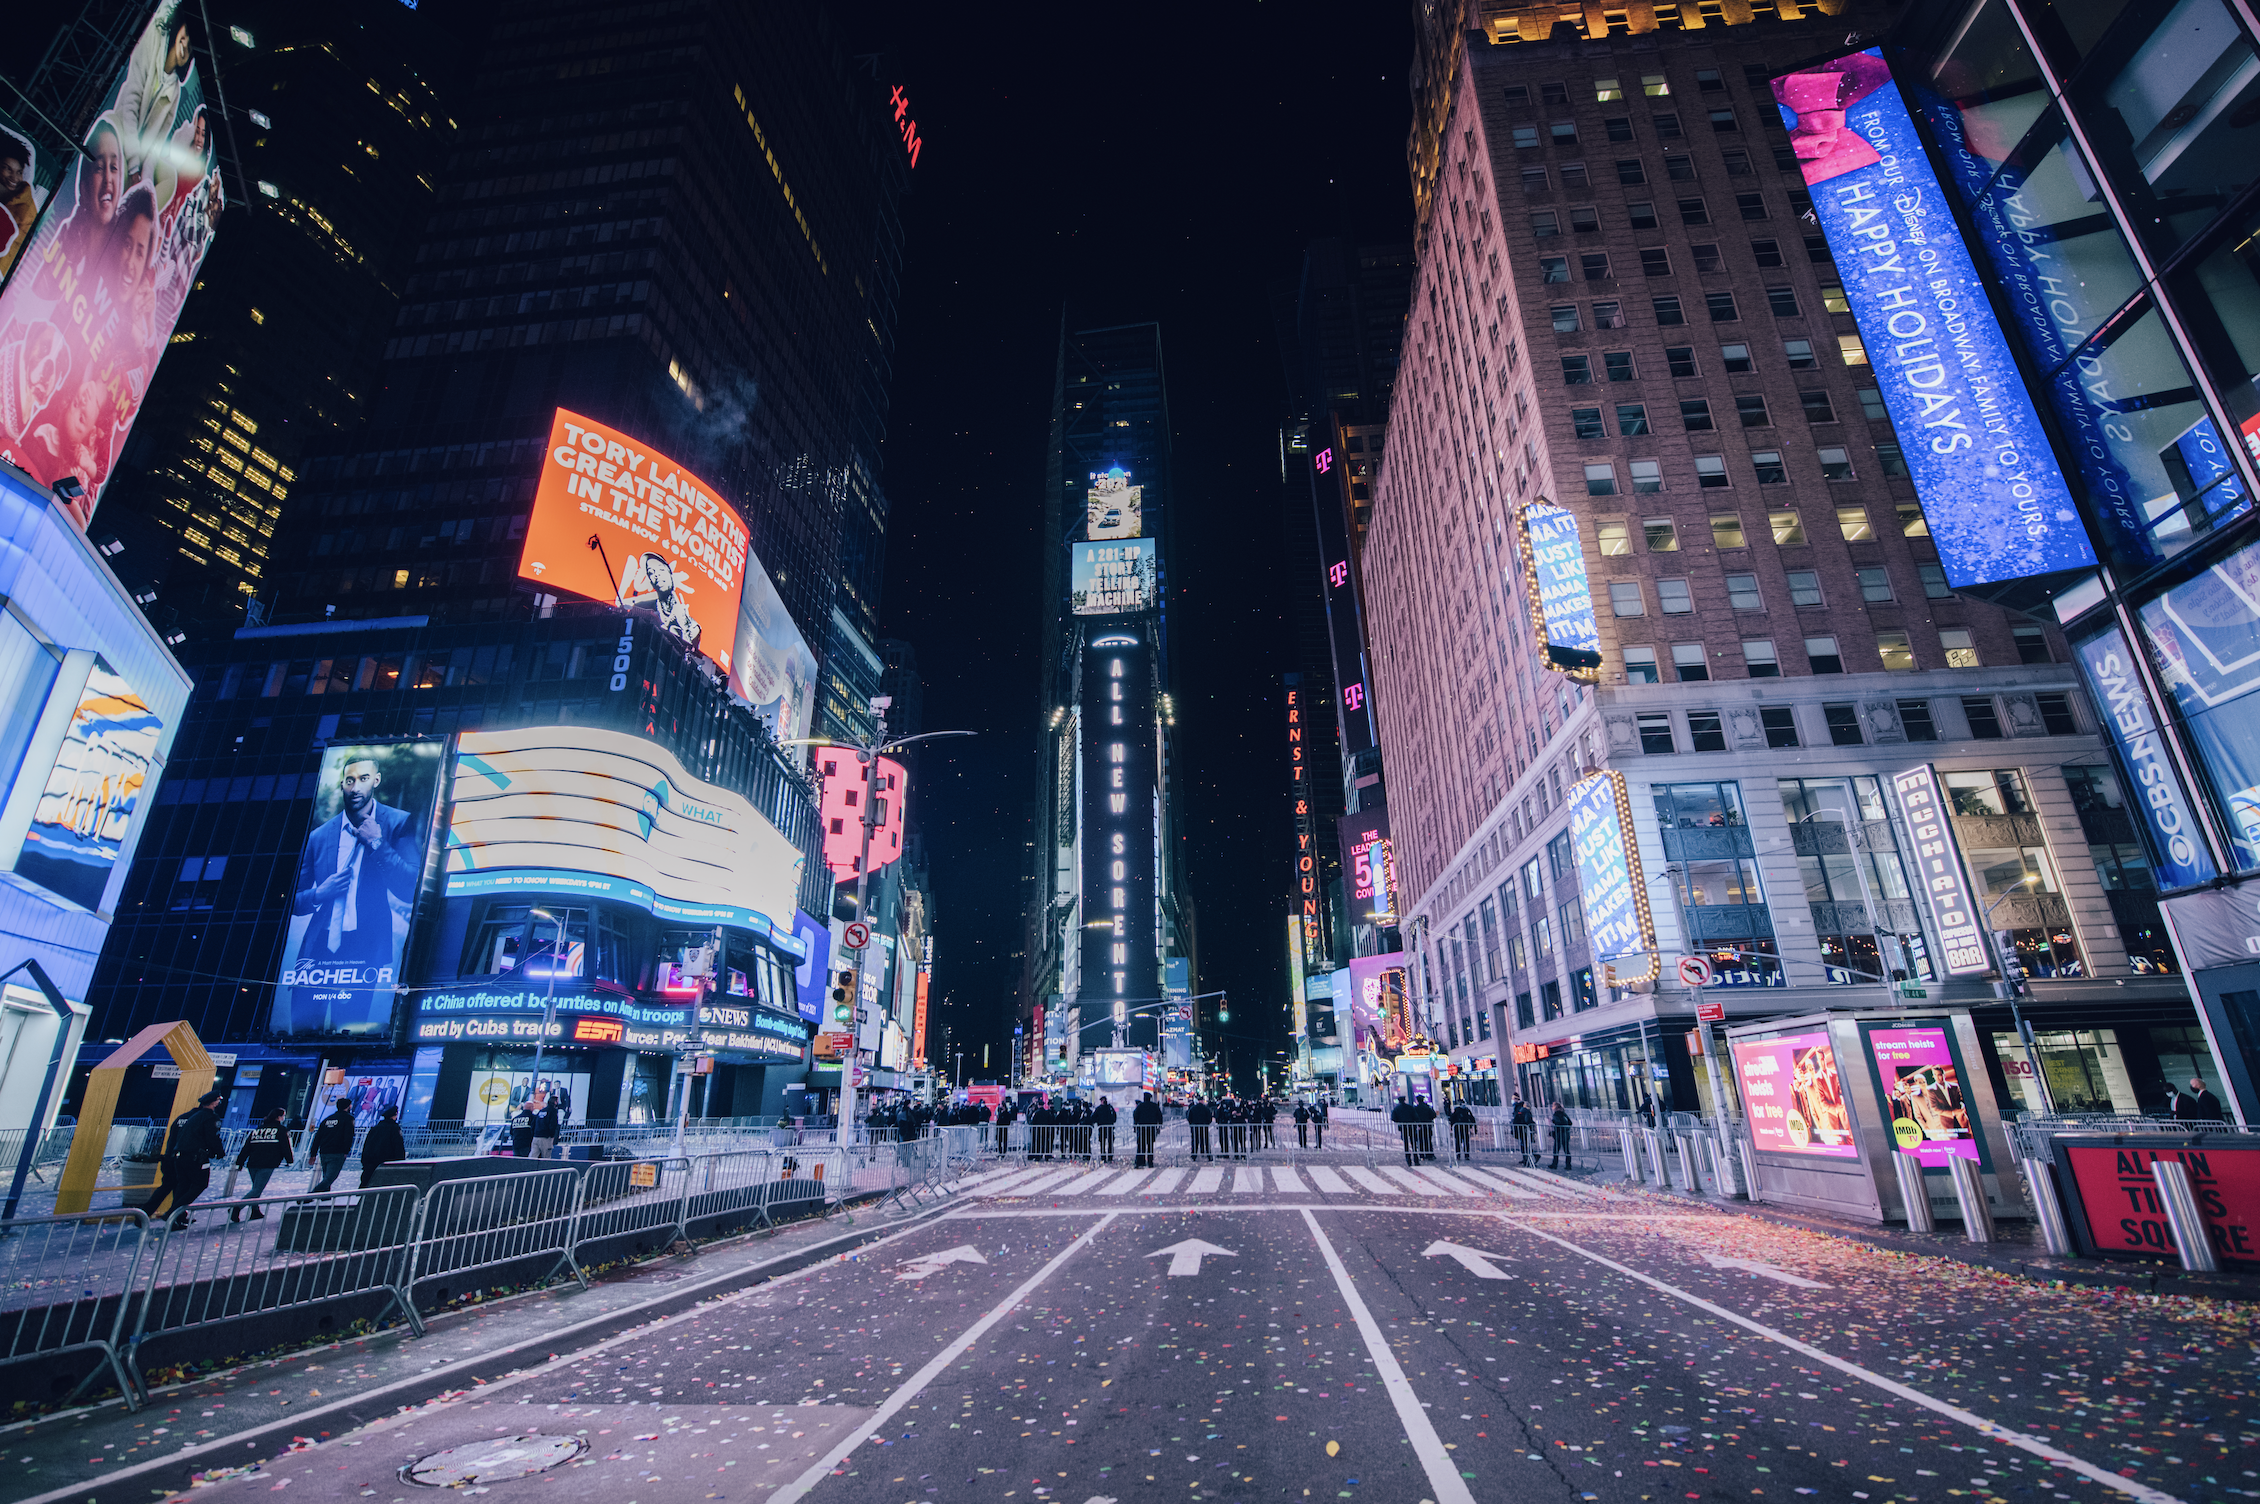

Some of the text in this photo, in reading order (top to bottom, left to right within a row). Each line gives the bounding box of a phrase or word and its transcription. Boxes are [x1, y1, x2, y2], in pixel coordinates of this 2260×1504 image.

[890, 85, 921, 169] H&M
[1860, 110, 1892, 157] FROM
[1878, 152, 1905, 188] OUR
[1918, 248, 1942, 277] ON
[42, 240, 105, 363] JINGLE
[93, 276, 120, 339] WE
[1836, 181, 1973, 456] HAPPY HOLIDAYS
[1929, 280, 1982, 374] BROADWAY
[101, 361, 131, 421] JAM
[1967, 375, 2006, 445] FAMILY
[1995, 440, 2019, 467] TO
[564, 423, 747, 554] TORY LANEZ THE
[553, 446, 745, 574] GREATEST ARTIST
[580, 502, 660, 543] STREAM NOW
[2005, 471, 2049, 543] YOURS,
[567, 473, 735, 588] IN THE WORLD.
[1087, 546, 1141, 563] A 281-HP
[1094, 561, 1134, 577] STORY
[1533, 541, 1575, 567] JUST
[1086, 590, 1143, 607] MACHINE
[1089, 576, 1139, 592] TELLING
[1539, 579, 1586, 603] MAMA
[1542, 595, 1592, 620] MAKES
[610, 618, 634, 691] 1500
[1110, 659, 1123, 725] ALL
[2096, 653, 2154, 761] NEWS
[1287, 691, 1304, 780] ERNST
[1110, 743, 1126, 813] NEW
[682, 801, 723, 824] WHAT
[1295, 799, 1308, 815] &
[2138, 761, 2182, 835] CBS
[1361, 829, 1379, 842] THE
[1576, 816, 1614, 867] JUST
[1897, 772, 1966, 927] MACCHIATO
[1298, 834, 1318, 939] YOUNG
[1584, 865, 1626, 909] MAMA
[1588, 882, 1633, 931] MAKES
[1112, 833, 1126, 1023] SORENTO
[1948, 946, 1983, 968] BAR
[281, 966, 394, 986] BACHELOR
[313, 993, 327, 1001] MON
[337, 991, 352, 1000] abc
[434, 994, 465, 1010] China
[467, 993, 524, 1009] offered
[604, 1000, 618, 1013] on
[642, 1008, 685, 1025] troops
[449, 1020, 464, 1038] by
[466, 1020, 508, 1036] Cubs
[574, 1020, 623, 1042] ESPN
[711, 1008, 748, 1027] NEWS
[701, 1031, 728, 1046] fear
[1875, 1039, 1935, 1050] stream heists
[1878, 1050, 1910, 1060] for free
[1959, 1022, 1981, 1071] Newsstand
[1744, 1061, 1775, 1077] stream
[1747, 1079, 1774, 1096] heists
[1752, 1102, 1784, 1119] for free
[252, 1128, 278, 1136] NYPD
[1895, 1126, 1918, 1135] IMDb
